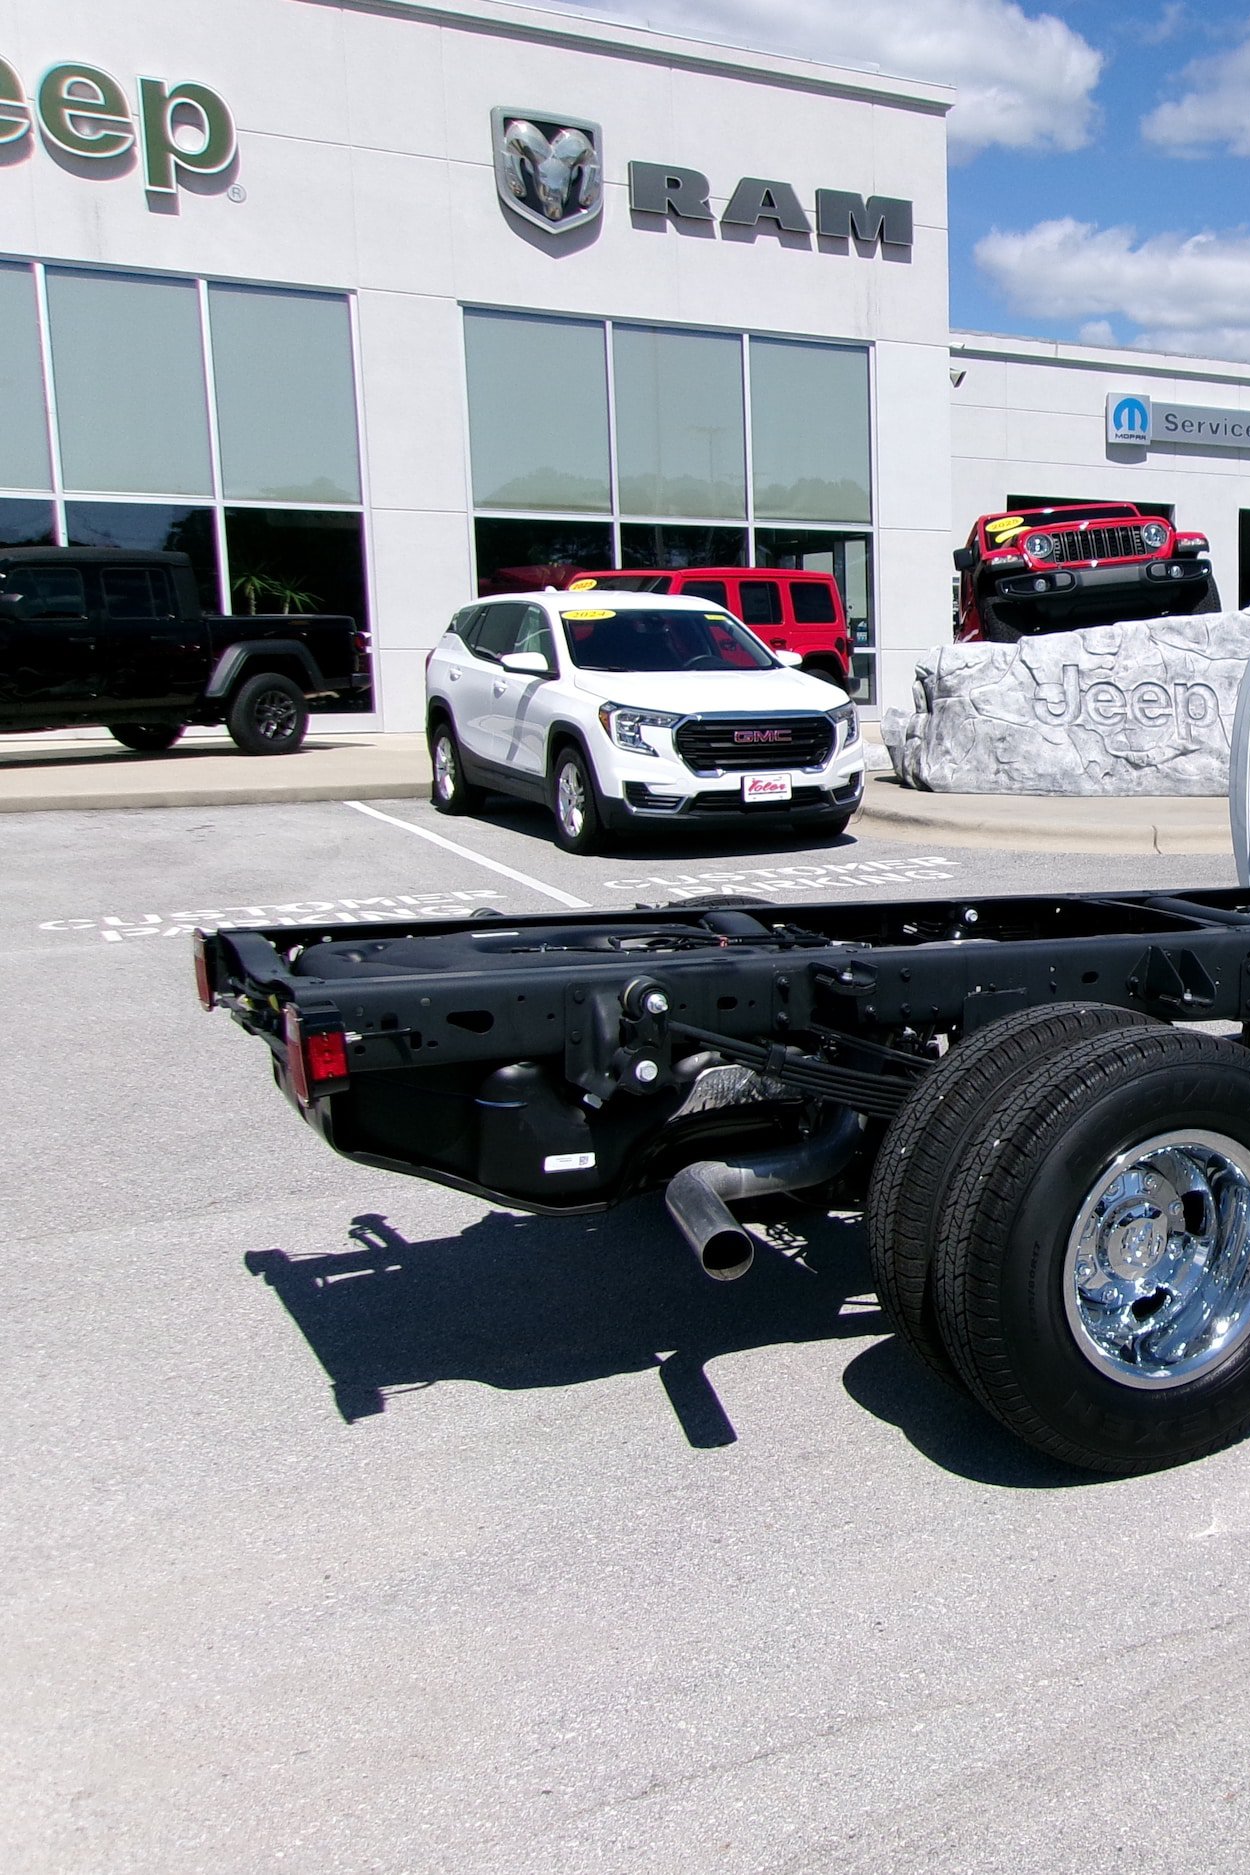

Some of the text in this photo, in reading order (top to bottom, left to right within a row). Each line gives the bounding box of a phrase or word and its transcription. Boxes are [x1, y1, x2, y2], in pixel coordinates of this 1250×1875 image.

[627, 160, 913, 248] RAM
[1114, 432, 1147, 442] MOPAR
[1033, 664, 1219, 743] Jeep
[734, 730, 792, 743] GMC
[604, 856, 962, 890] CUSTOMER
[668, 869, 955, 899] PARKING
[38, 889, 508, 931] CUSTOMER
